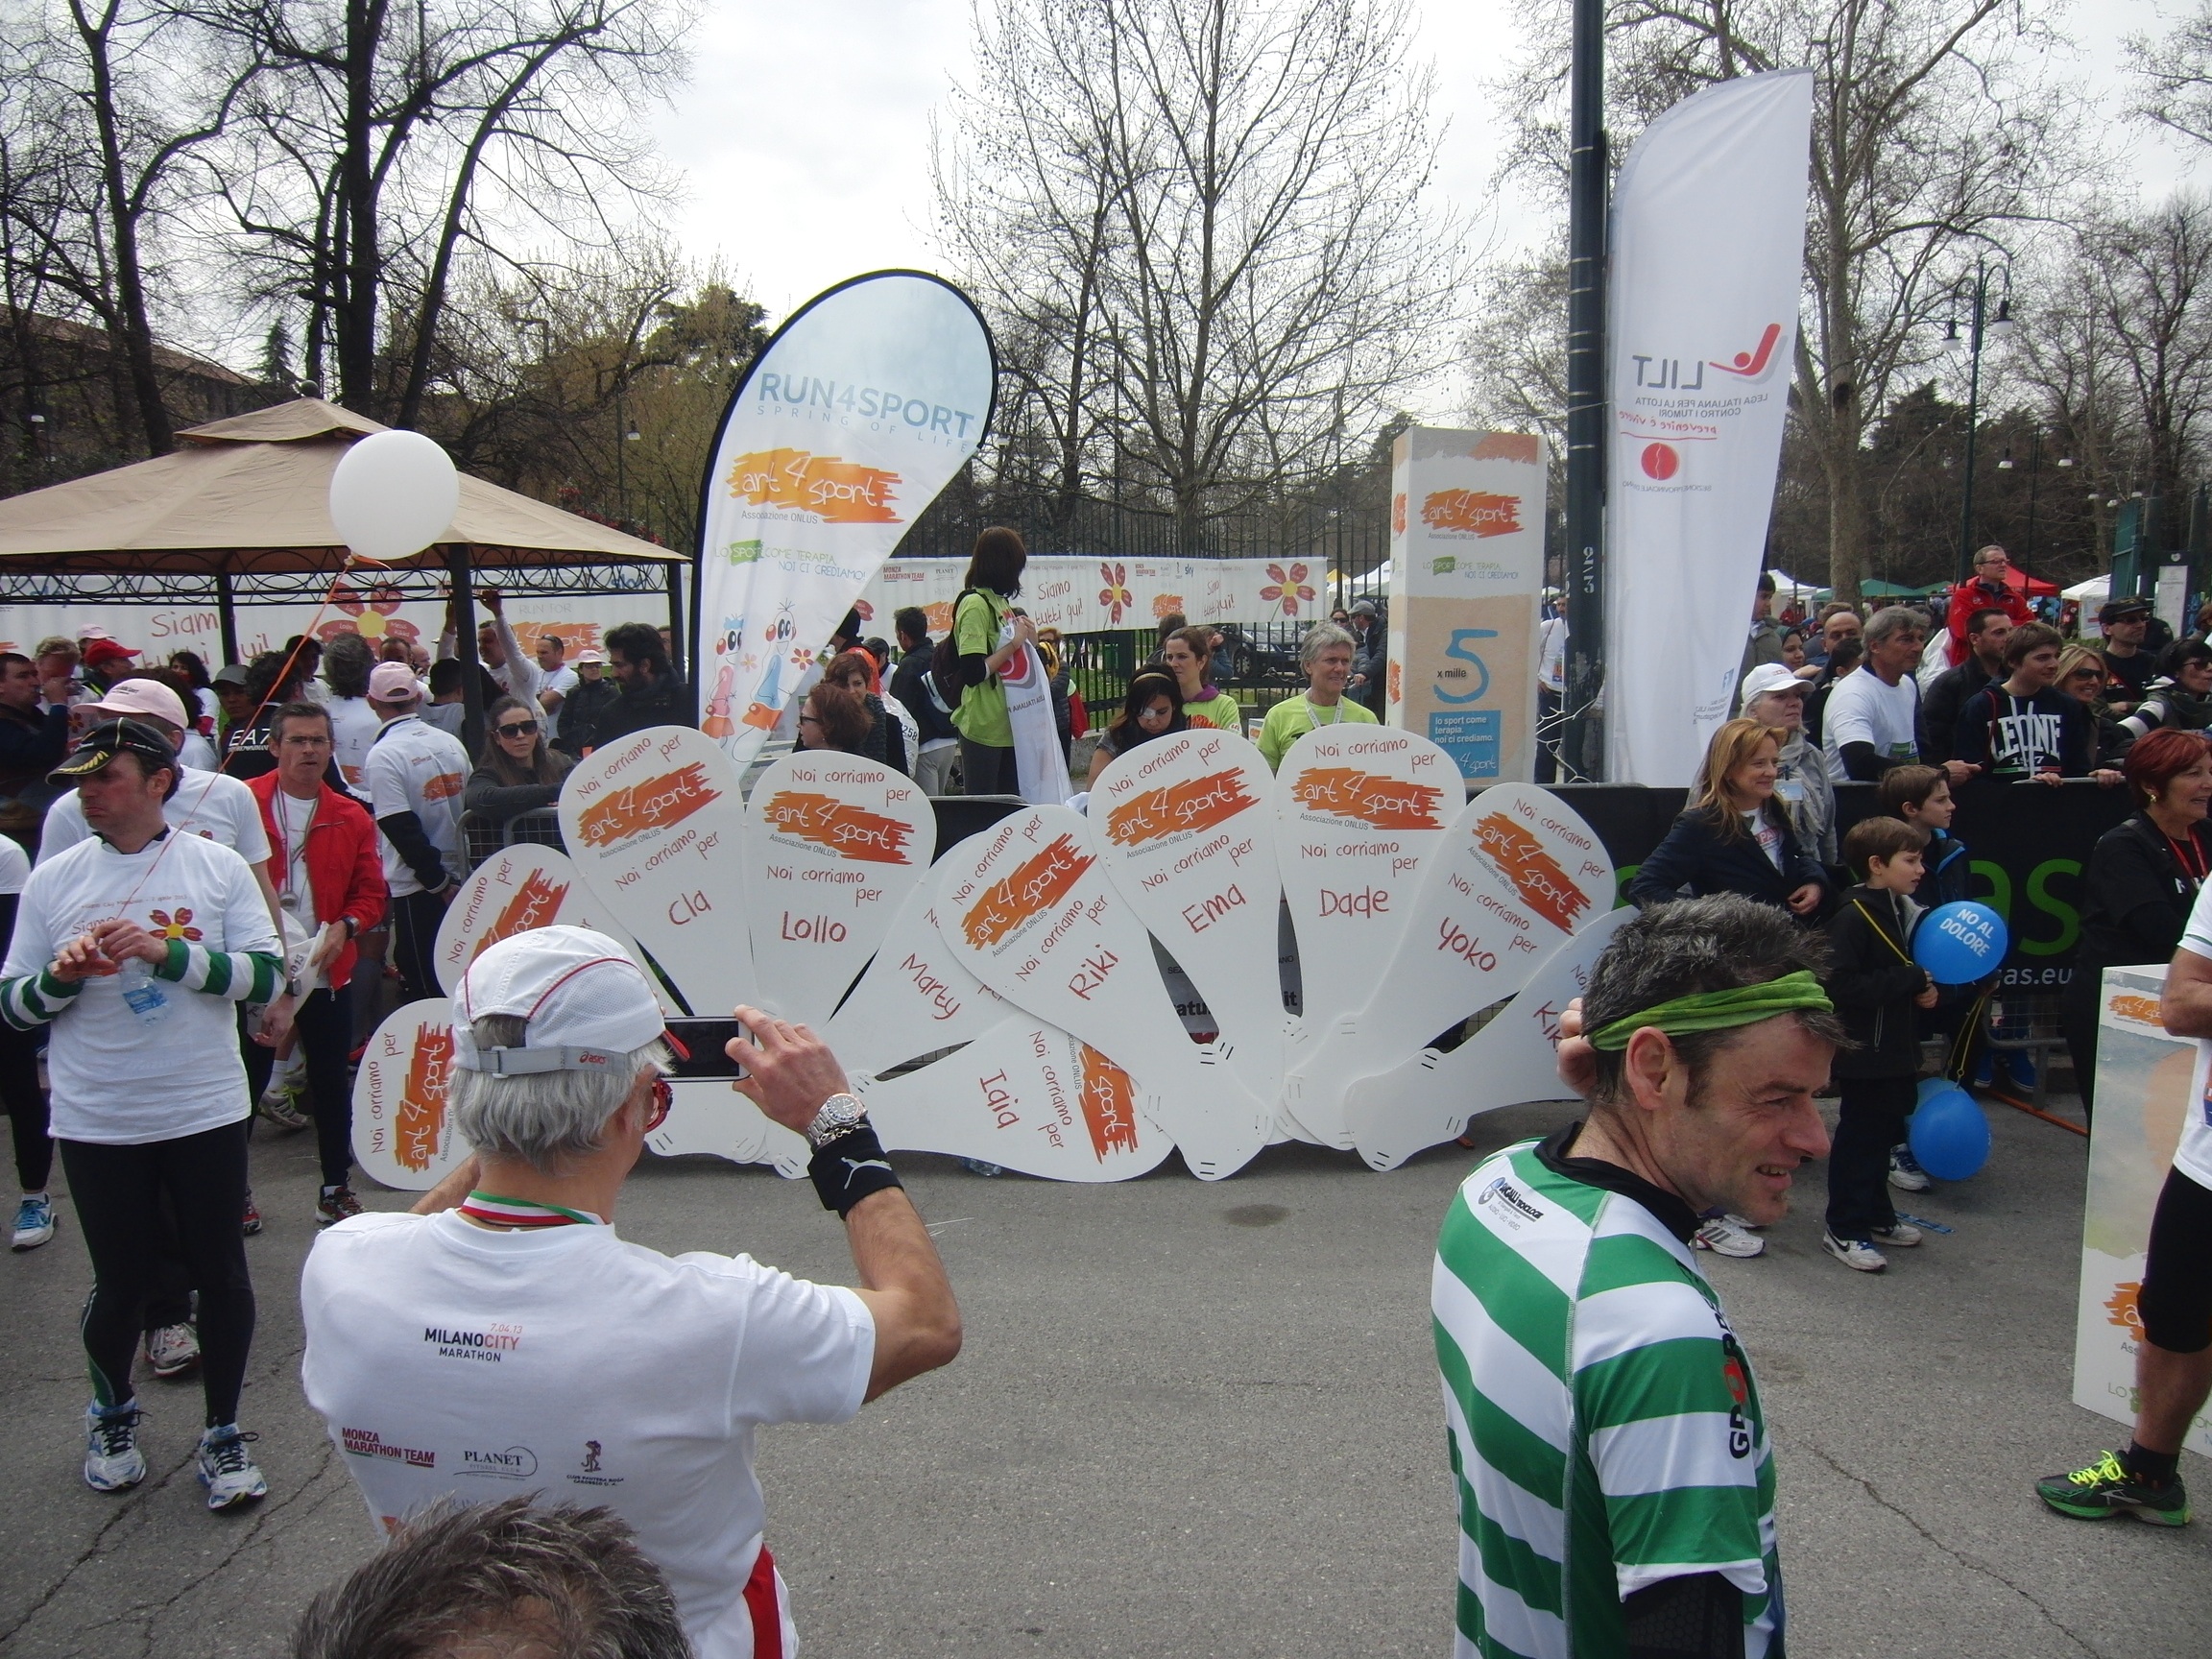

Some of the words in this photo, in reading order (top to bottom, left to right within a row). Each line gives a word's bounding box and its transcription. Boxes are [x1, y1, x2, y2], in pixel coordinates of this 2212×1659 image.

[758, 373, 974, 439] RUN4SPORT
[757, 404, 849, 426] SPRING
[871, 421, 897, 434] OF
[917, 432, 969, 454] LIFE
[741, 462, 781, 493] art
[783, 456, 813, 487] 4
[808, 476, 878, 506] sport
[790, 512, 818, 524] ONLUS
[1429, 499, 1454, 520] art
[1455, 493, 1471, 516] 4
[1469, 501, 1508, 527] sport
[764, 546, 792, 560] COME
[778, 561, 796, 572] NOI
[799, 563, 810, 573] CI
[814, 565, 866, 582] CREDIAMO!
[1038, 580, 1070, 600] Siamo
[518, 604, 544, 615] RUN
[549, 602, 572, 614] FOR
[940, 603, 950, 621] 4
[1035, 603, 1062, 626] tutti
[1432, 629, 1499, 704] 5
[1437, 669, 1443, 678] x
[1445, 667, 1467, 678] mille
[1434, 716, 1443, 725] lo
[1444, 716, 1464, 726] sport
[1434, 725, 1464, 735] terapia.
[658, 733, 683, 764] per
[1197, 738, 1222, 766] per
[1314, 743, 1339, 759] Noi
[1348, 737, 1408, 756] corriamo
[1434, 735, 1447, 744] noi
[576, 773, 603, 801] Noi
[603, 735, 653, 781] corriamo
[791, 768, 816, 783] Noi
[824, 769, 885, 784] corriamo
[1108, 774, 1135, 799] Noi
[1138, 738, 1190, 779] corriamo
[1410, 752, 1436, 774] per
[1460, 752, 1471, 768] 4
[1469, 754, 1498, 775] sport
[588, 808, 623, 841] art
[616, 787, 637, 818] 4
[640, 775, 698, 823] sport
[885, 787, 911, 807] per
[1118, 808, 1154, 839] art
[1149, 789, 1170, 819] 4
[1174, 780, 1234, 826] sport
[1304, 778, 1339, 803] art
[1342, 774, 1366, 800] 4
[1361, 790, 1422, 817] sport
[775, 803, 809, 829] art
[815, 803, 839, 827] 4
[832, 822, 891, 851] sport
[1022, 813, 1044, 843] per
[1300, 812, 1344, 828] Associazione
[1344, 818, 1370, 831] ONLUS
[1513, 798, 1537, 819] Noi
[1540, 816, 1593, 852] corriamo
[598, 838, 638, 860] Associazione
[637, 827, 661, 844] ONLUS
[697, 830, 721, 860] per
[768, 833, 812, 853] Associazione
[811, 844, 838, 858] ONLUS
[1126, 839, 1168, 859] Associazione
[1168, 830, 1193, 847] ONLUS
[1228, 837, 1254, 867] per
[1301, 843, 1328, 859] Noi
[1335, 841, 1400, 857] corriamo
[1482, 826, 1513, 857] art
[1517, 842, 1545, 863] 4
[494, 857, 514, 885] per
[614, 865, 641, 891] Noi
[644, 828, 698, 873] corriamo
[767, 863, 793, 880] Noi
[801, 867, 865, 885] corriamo
[951, 878, 975, 905] Noi
[974, 825, 1014, 878] corriamo
[1141, 868, 1169, 893] Noi
[1173, 834, 1230, 875] corriamo
[1392, 856, 1418, 878] per
[1467, 846, 1500, 879] Associazione
[1498, 876, 1519, 897] ONLUS
[1579, 857, 1606, 879] per
[855, 886, 883, 908] per
[975, 905, 1007, 940] art
[998, 878, 1018, 906] 4
[1022, 852, 1072, 907] sport
[1319, 885, 1390, 919] Dade
[1448, 873, 1472, 897] Noi
[1477, 893, 1530, 931] corriamo
[1520, 867, 1571, 913] sport
[447, 935, 466, 965] Noi
[460, 876, 489, 934] corriamo
[667, 888, 713, 926] Cla
[1084, 894, 1109, 926] per
[1181, 883, 1248, 934] Ema
[781, 910, 847, 944] Lollo
[992, 931, 1026, 958] Associazione
[1024, 909, 1048, 932] ONLUS
[1939, 917, 1991, 958] DOLORE
[1957, 908, 1980, 926] NO
[1976, 921, 1994, 939] AL
[1016, 954, 1041, 981] Noi
[1041, 899, 1084, 954] corriamo
[1437, 916, 1498, 974] Yoko
[1508, 932, 1538, 955] per
[899, 952, 961, 1020] Marty
[1068, 944, 1120, 1000] Riki
[2114, 1000, 2133, 1013] art
[2134, 999, 2148, 1012] 4
[384, 1032, 404, 1058] per
[588, 1054, 607, 1065] asics
[416, 1040, 450, 1104] sport
[1029, 1030, 1051, 1058] Noi
[1042, 1063, 1073, 1127] corriamo
[1071, 1065, 1082, 1091] ONLUS
[365, 1060, 383, 1120] corriamo
[979, 1069, 1021, 1129] Iaia
[407, 1097, 429, 1122] 4
[1089, 1075, 1129, 1137] sport
[372, 1127, 386, 1154] Noi
[404, 1124, 431, 1162] art
[439, 1117, 454, 1163] Associazione
[1038, 1121, 1065, 1149] per
[424, 1327, 520, 1351] MILANOCITY
[490, 1323, 524, 1334] 7.04.13
[439, 1346, 502, 1362] MARATHON
[2107, 1382, 2128, 1398] LO
[342, 1427, 380, 1444] MONZA
[344, 1438, 402, 1459] MARATHON
[403, 1448, 436, 1464] TEAM
[464, 1450, 523, 1467] PLANET
